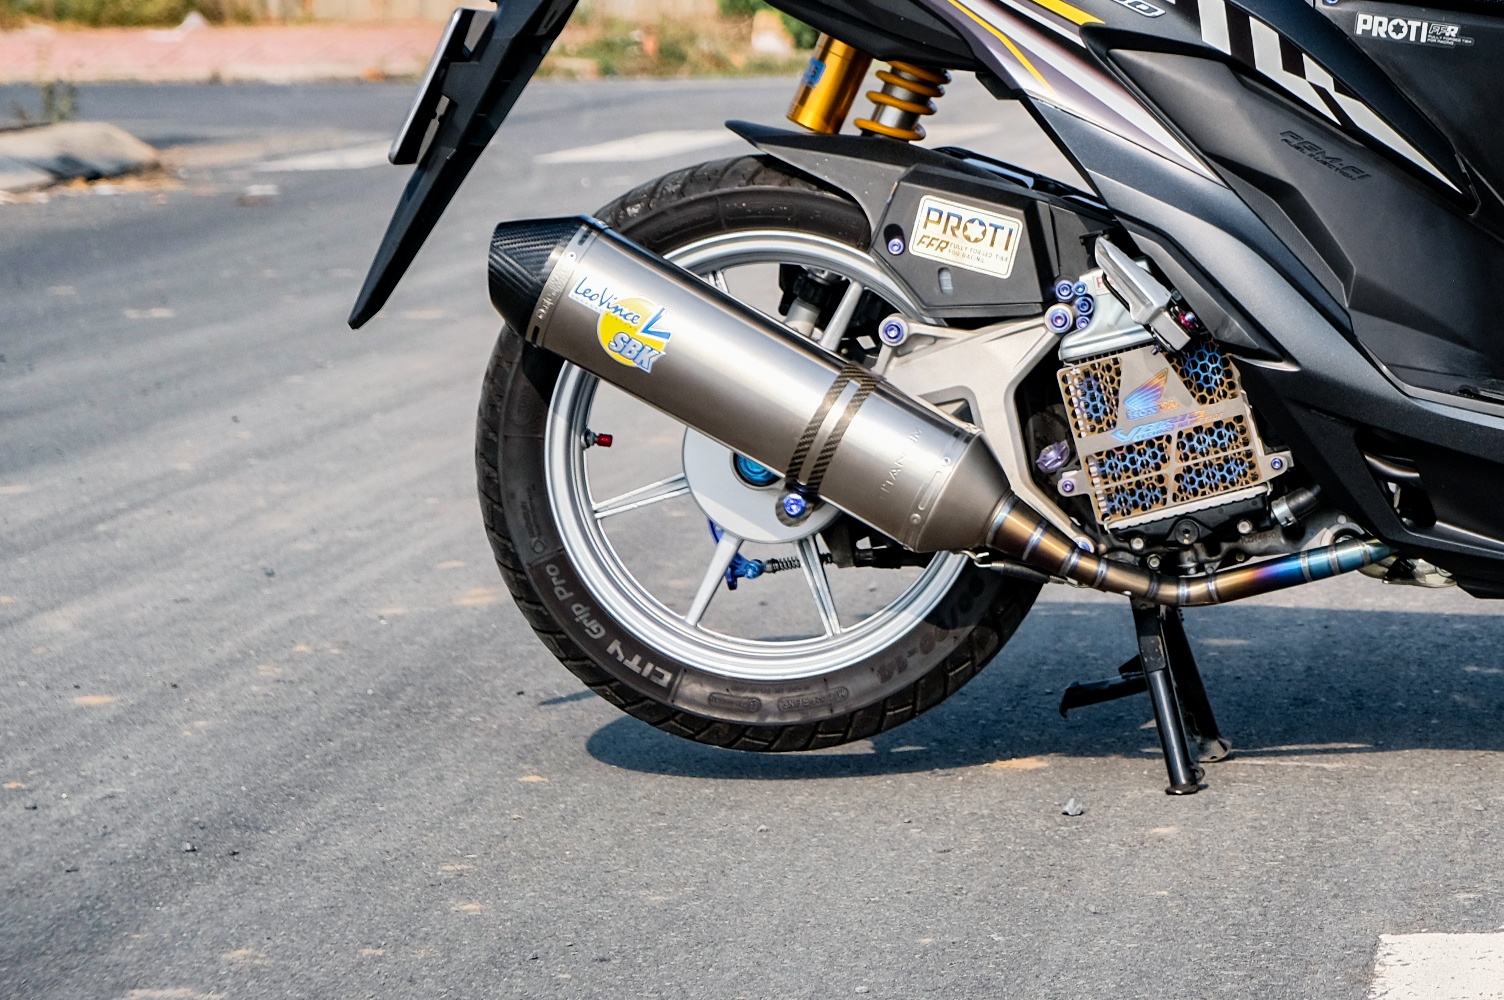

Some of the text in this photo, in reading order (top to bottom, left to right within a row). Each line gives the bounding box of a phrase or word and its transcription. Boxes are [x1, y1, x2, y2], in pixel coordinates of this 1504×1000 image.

[1356, 14, 1428, 43] PROTI
[917, 235, 950, 253] FFR
[923, 206, 1014, 252] PROTI
[575, 277, 640, 324] LeoVince
[608, 332, 661, 371] SBK
[545, 564, 673, 688] CITY Grip Pro
